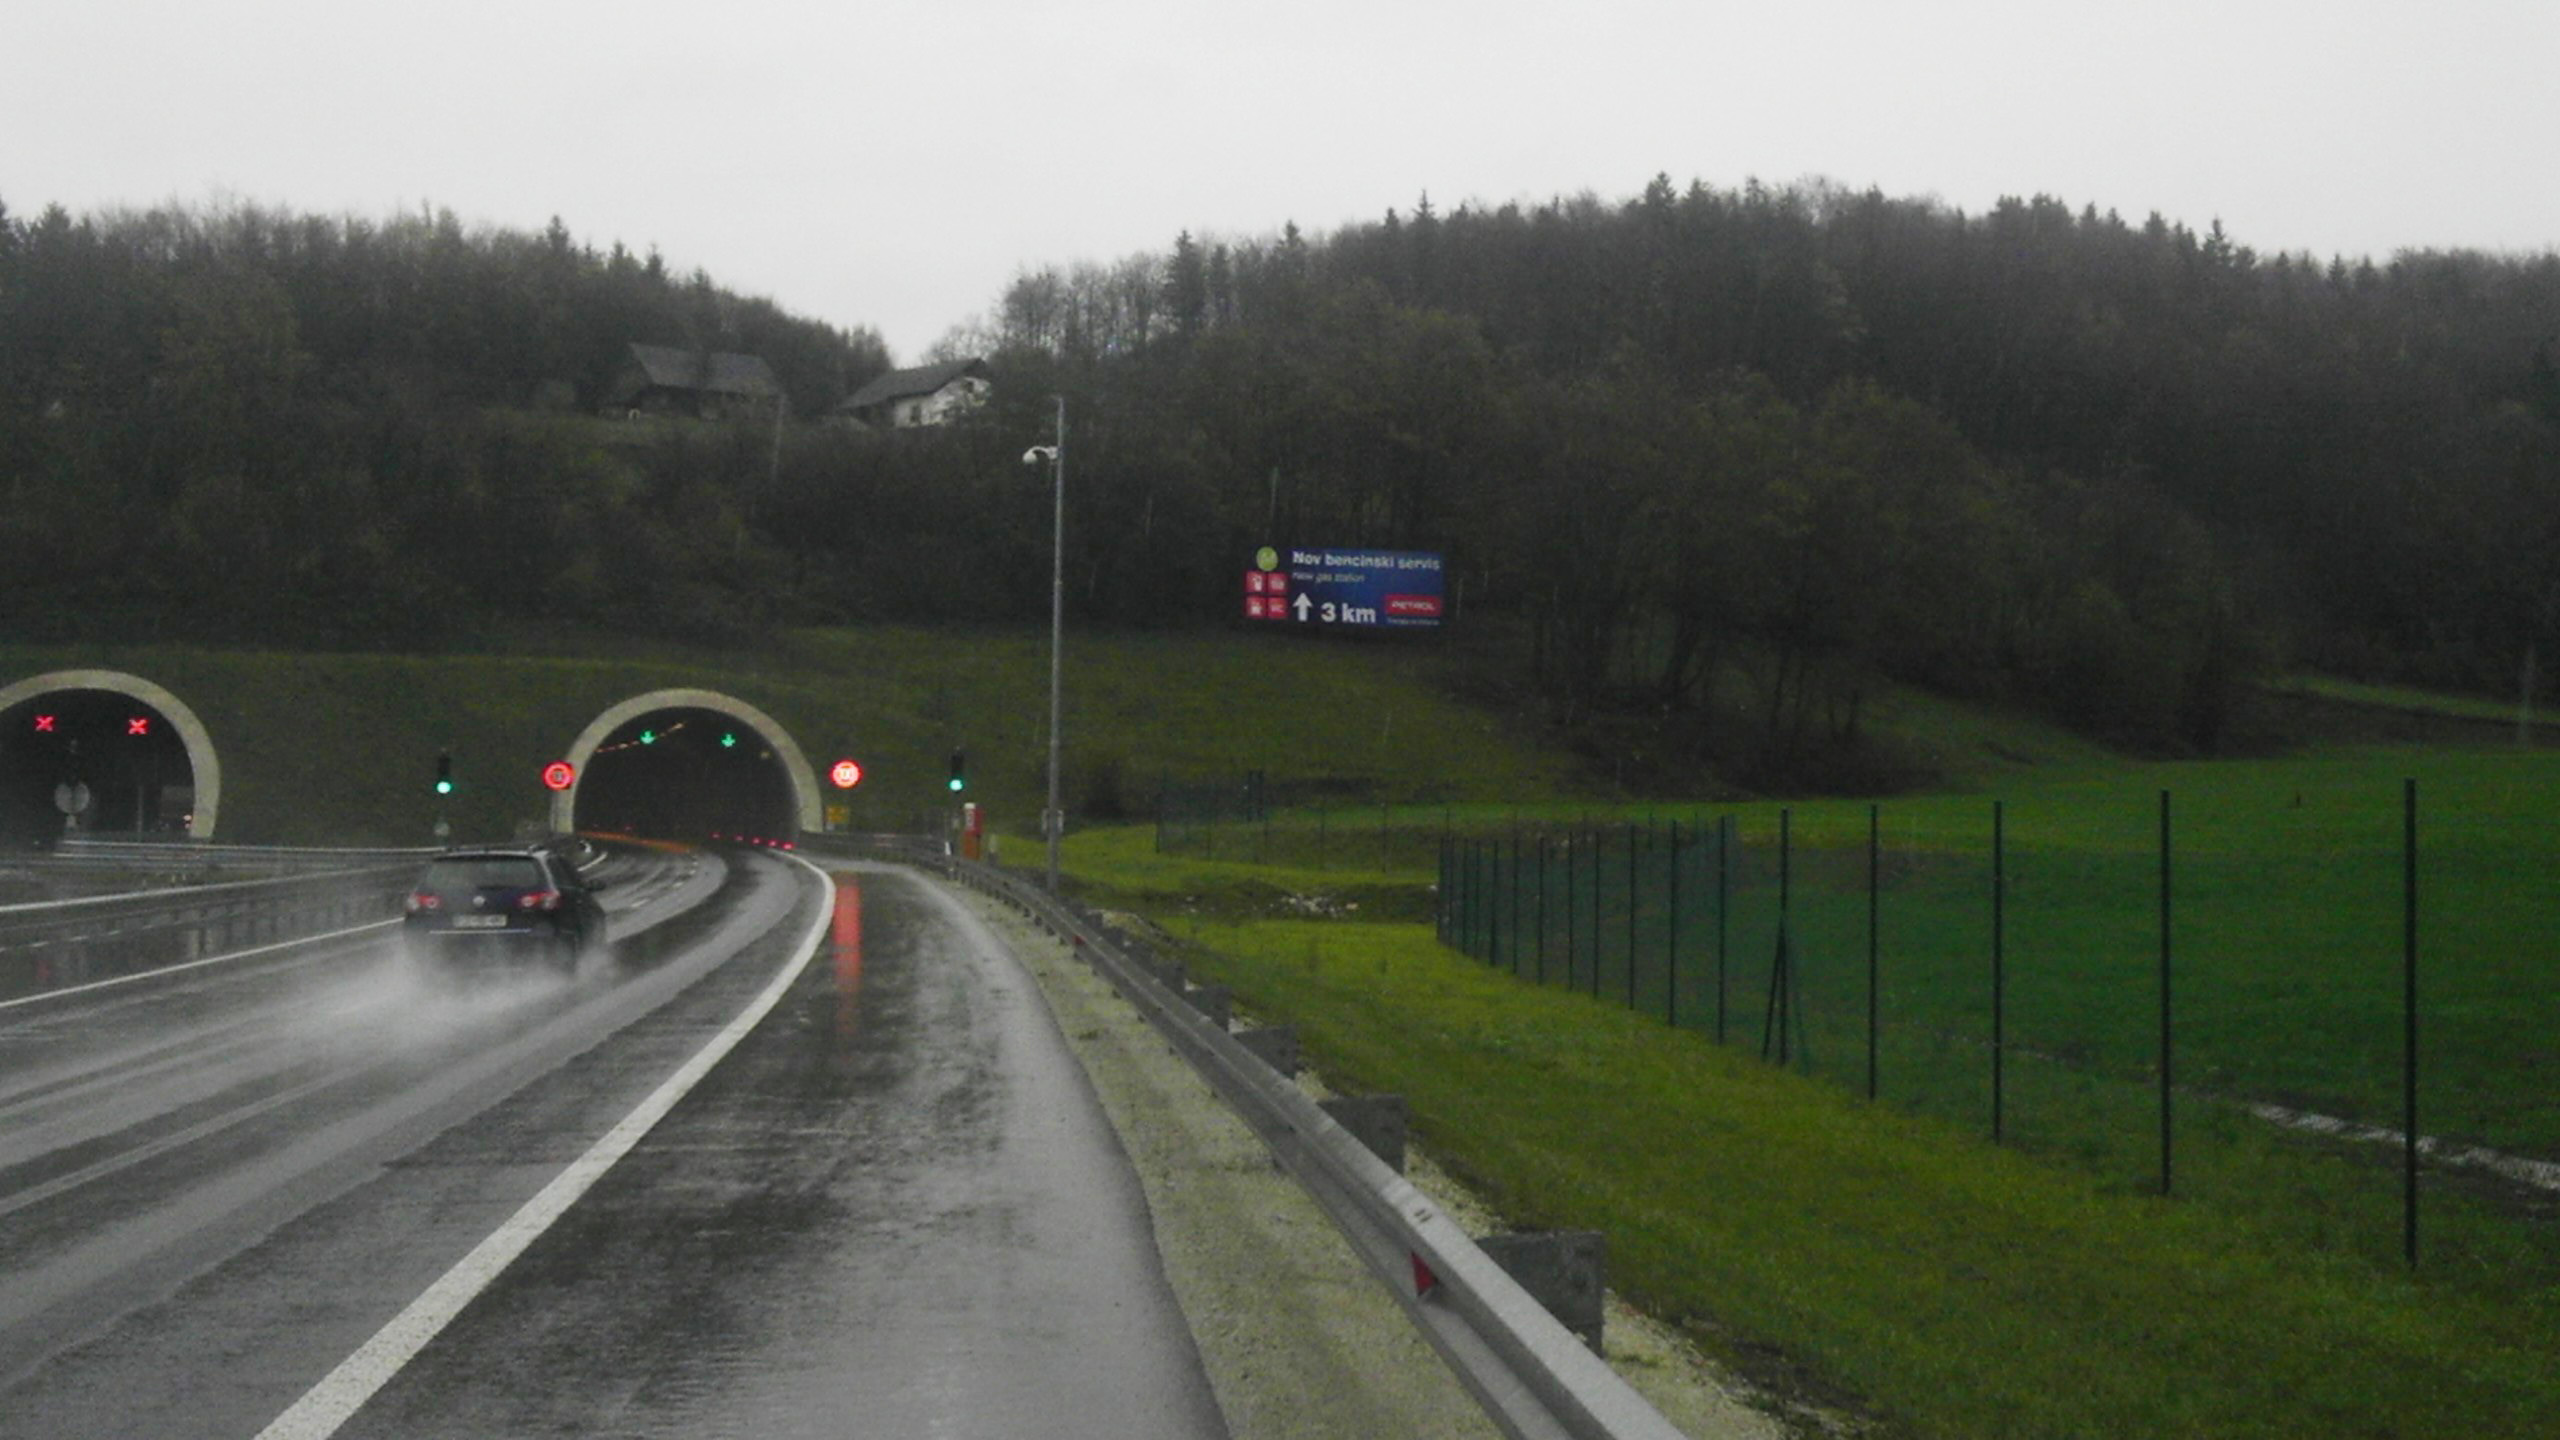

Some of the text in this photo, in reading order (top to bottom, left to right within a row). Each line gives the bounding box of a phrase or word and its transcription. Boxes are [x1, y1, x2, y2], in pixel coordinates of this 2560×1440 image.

[1292, 551, 1440, 570] Nov bencinski servis
[1320, 602, 1376, 623] 3 km
